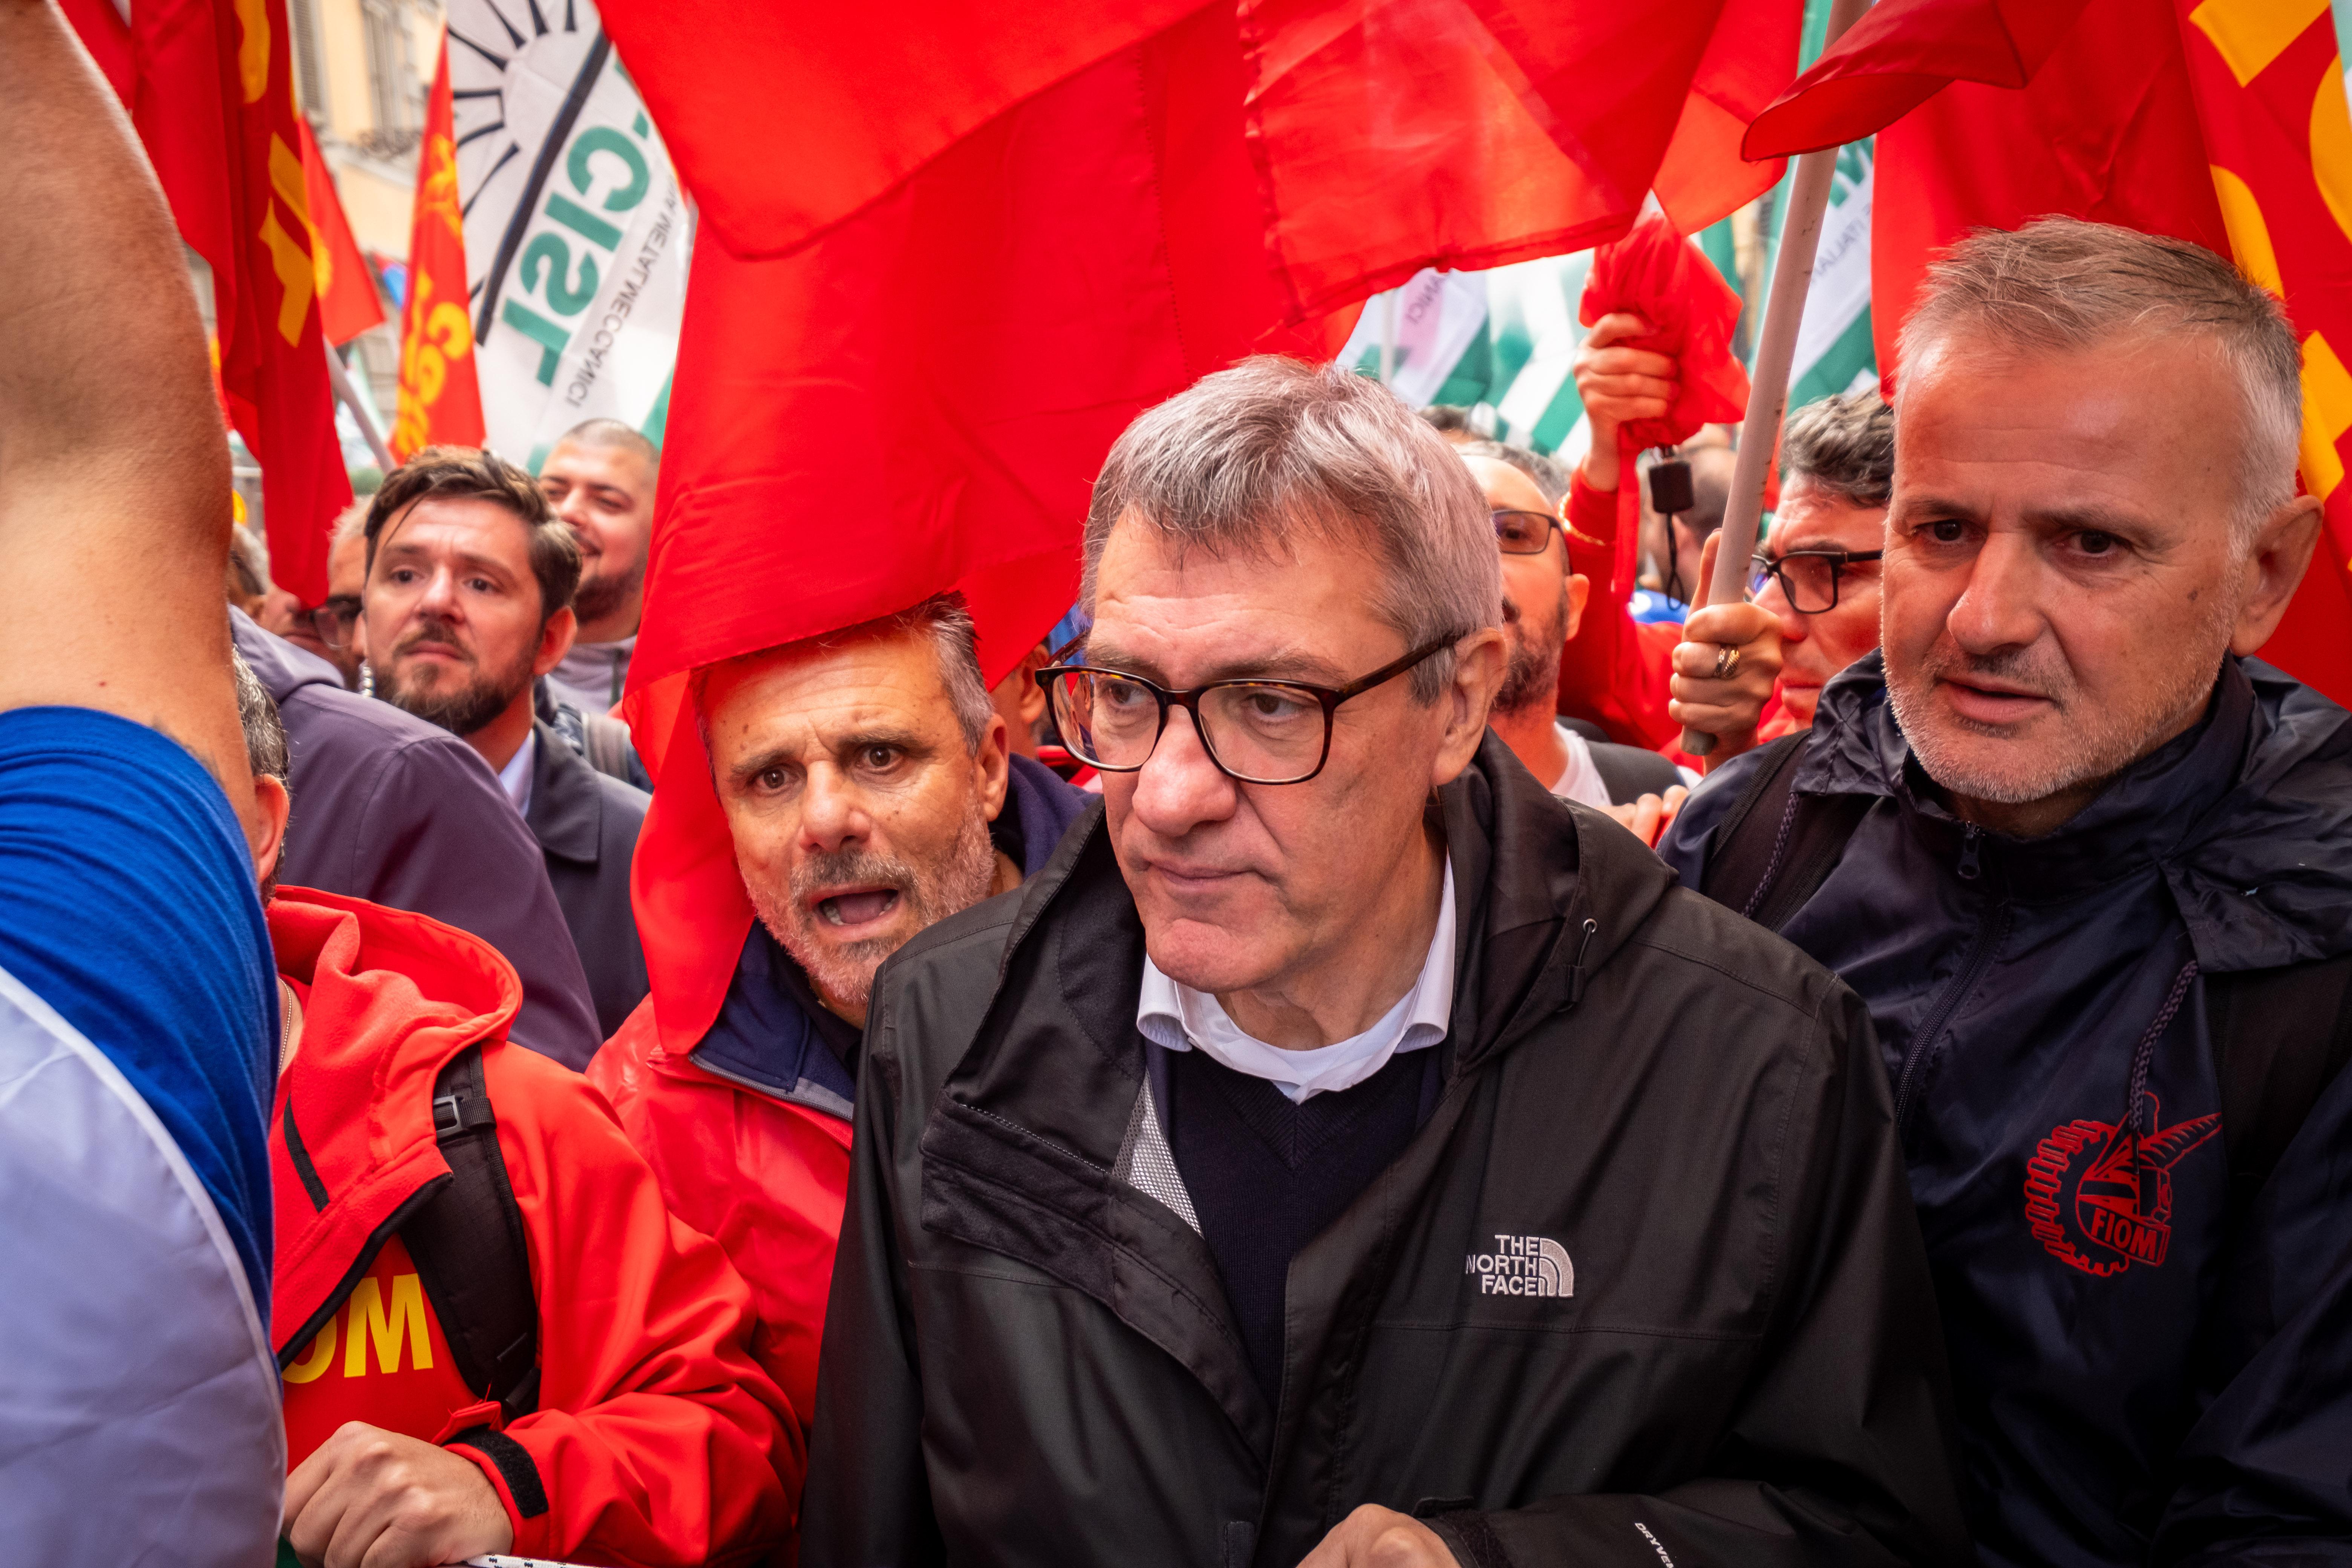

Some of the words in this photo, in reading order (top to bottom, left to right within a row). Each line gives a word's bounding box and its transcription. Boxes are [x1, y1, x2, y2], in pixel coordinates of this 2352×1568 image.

[1494, 1234, 1539, 1256] THE
[2091, 1207, 2157, 1261] FIOM
[1465, 1254, 1537, 1276] NORTH
[1482, 1274, 1537, 1296] FACE
